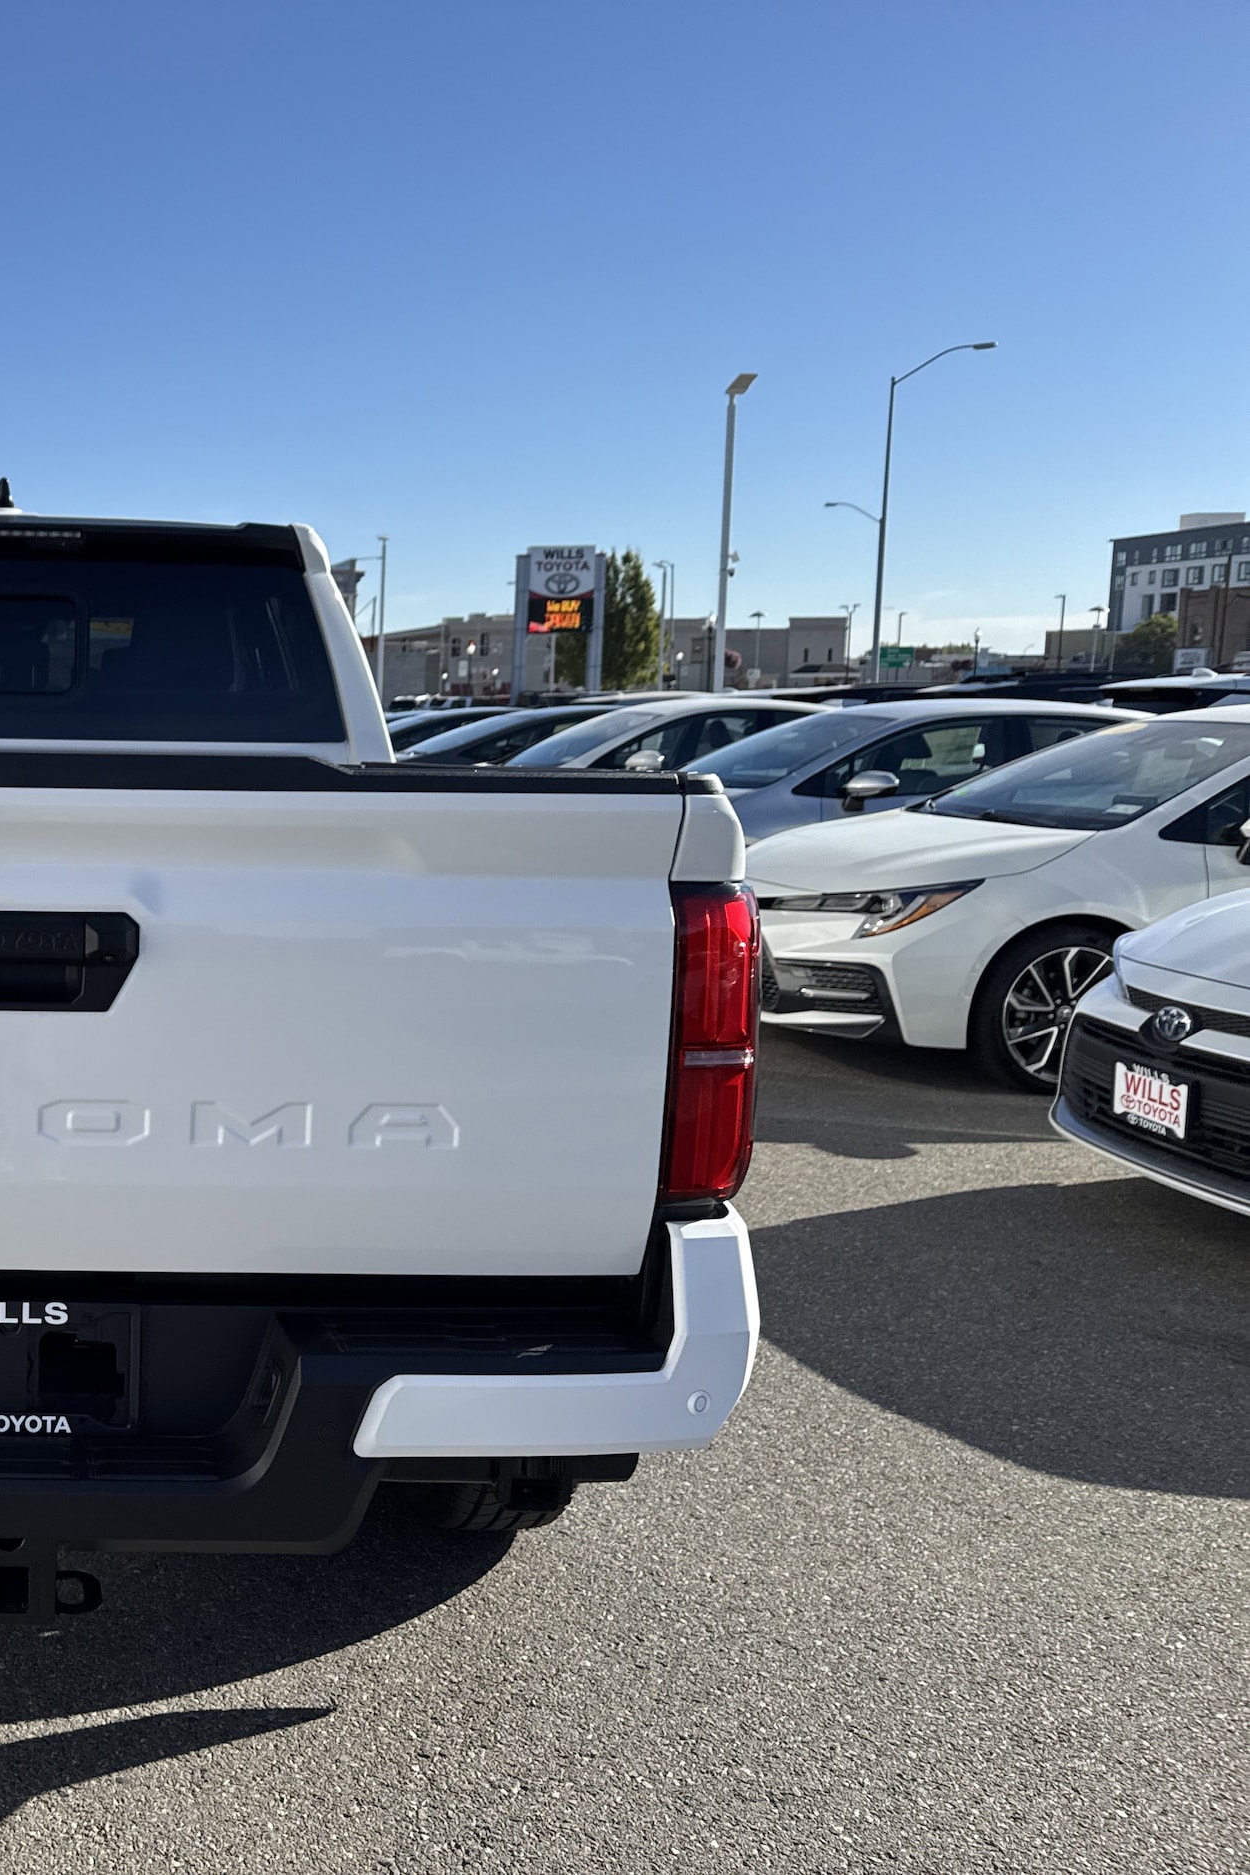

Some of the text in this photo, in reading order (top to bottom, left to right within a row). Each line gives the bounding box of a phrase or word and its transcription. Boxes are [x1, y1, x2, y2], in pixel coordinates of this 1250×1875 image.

[543, 548, 584, 559] WILLS
[535, 560, 590, 571] TOYOTA
[1124, 1072, 1181, 1111] WILLS
[1136, 1099, 1181, 1128] TOYOTA
[1136, 1116, 1167, 1136] TOYOTA
